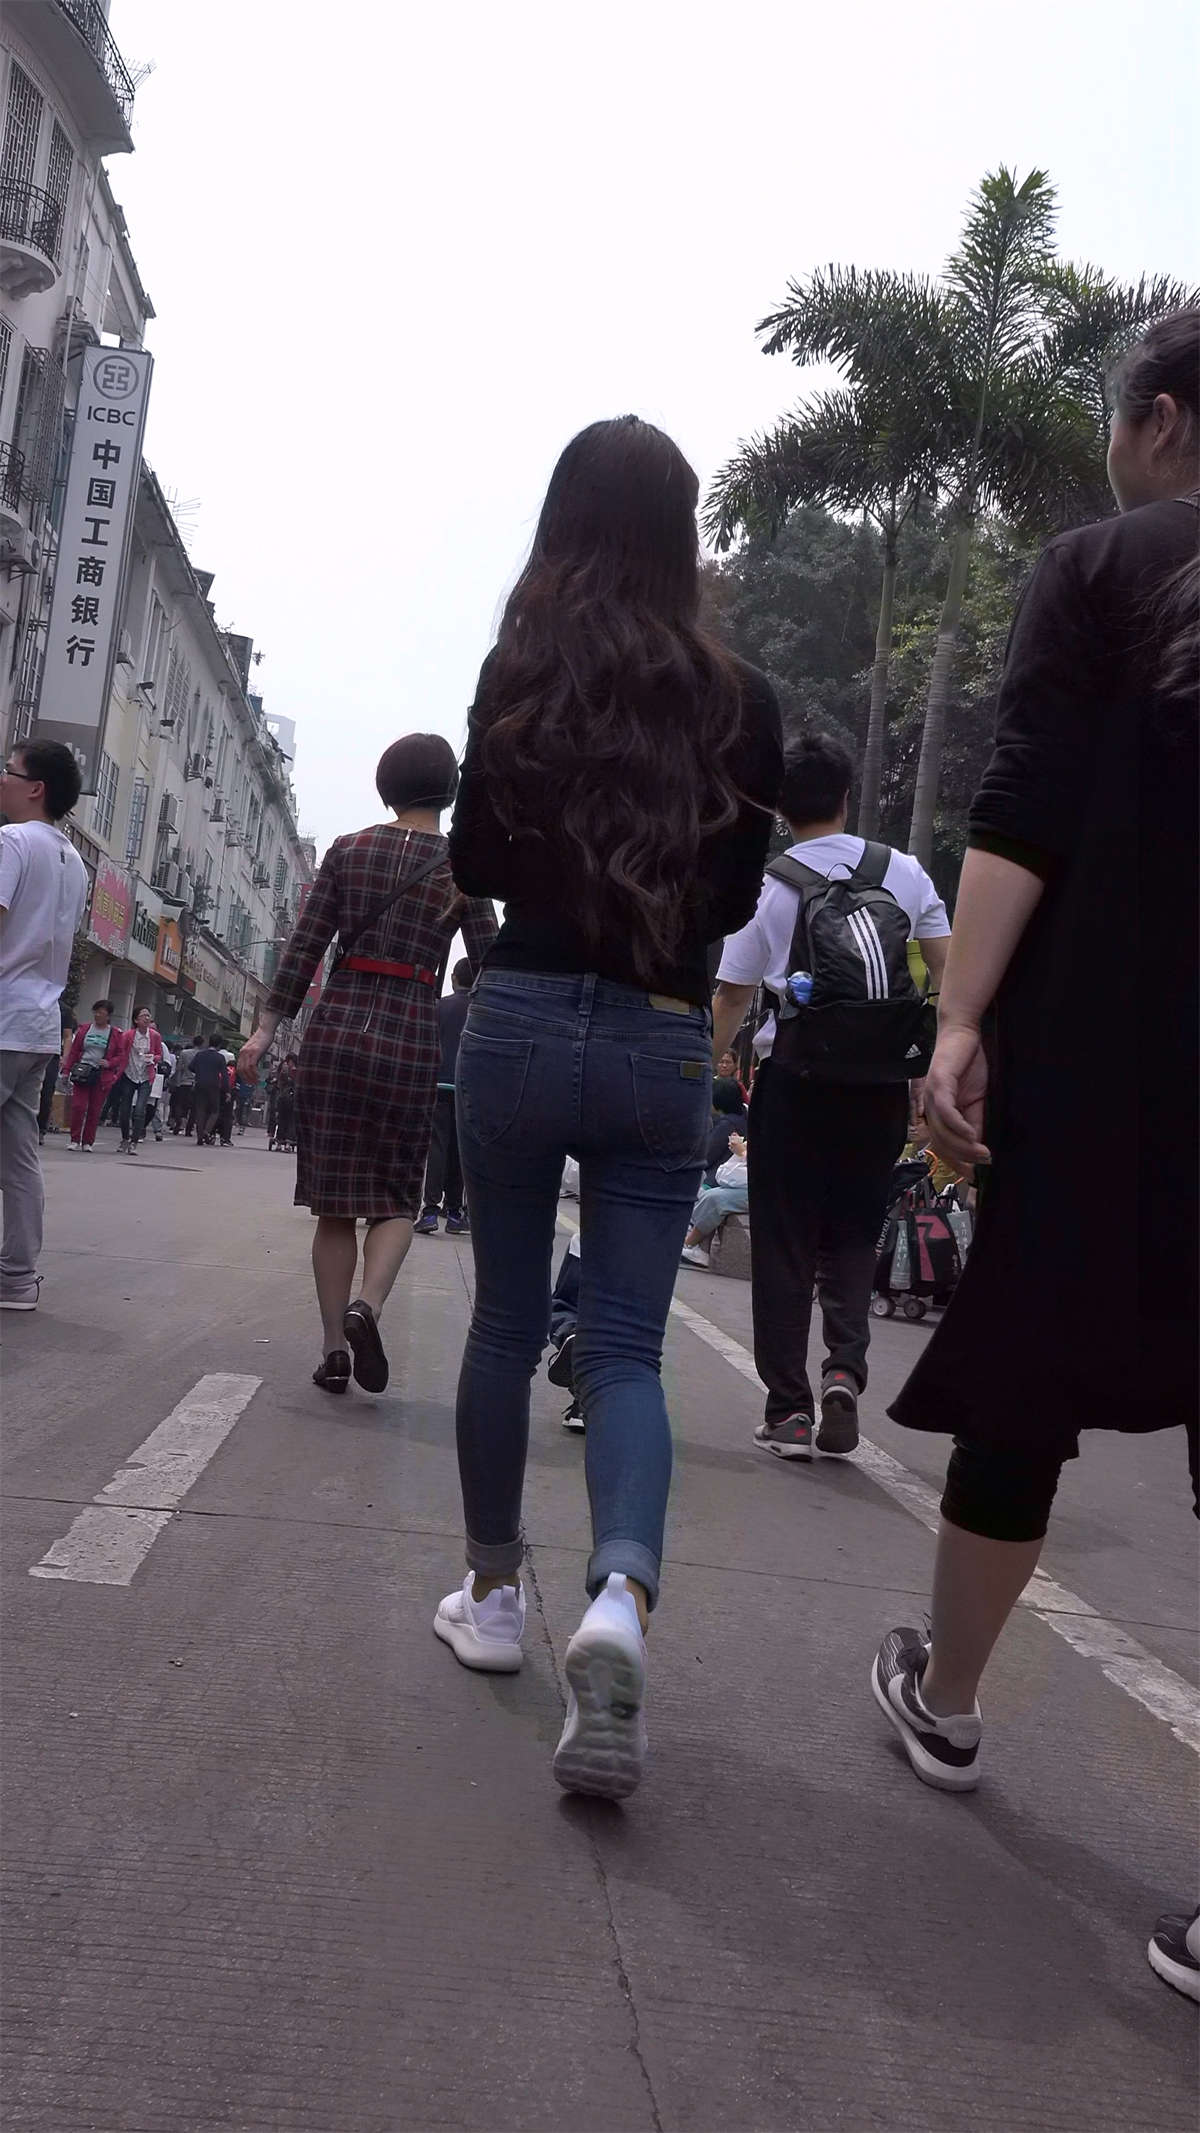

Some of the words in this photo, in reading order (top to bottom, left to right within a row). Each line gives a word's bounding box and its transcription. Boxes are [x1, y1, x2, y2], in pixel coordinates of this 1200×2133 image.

[87, 405, 136, 426] ICBC
[66, 439, 121, 667] 中国工商银行
